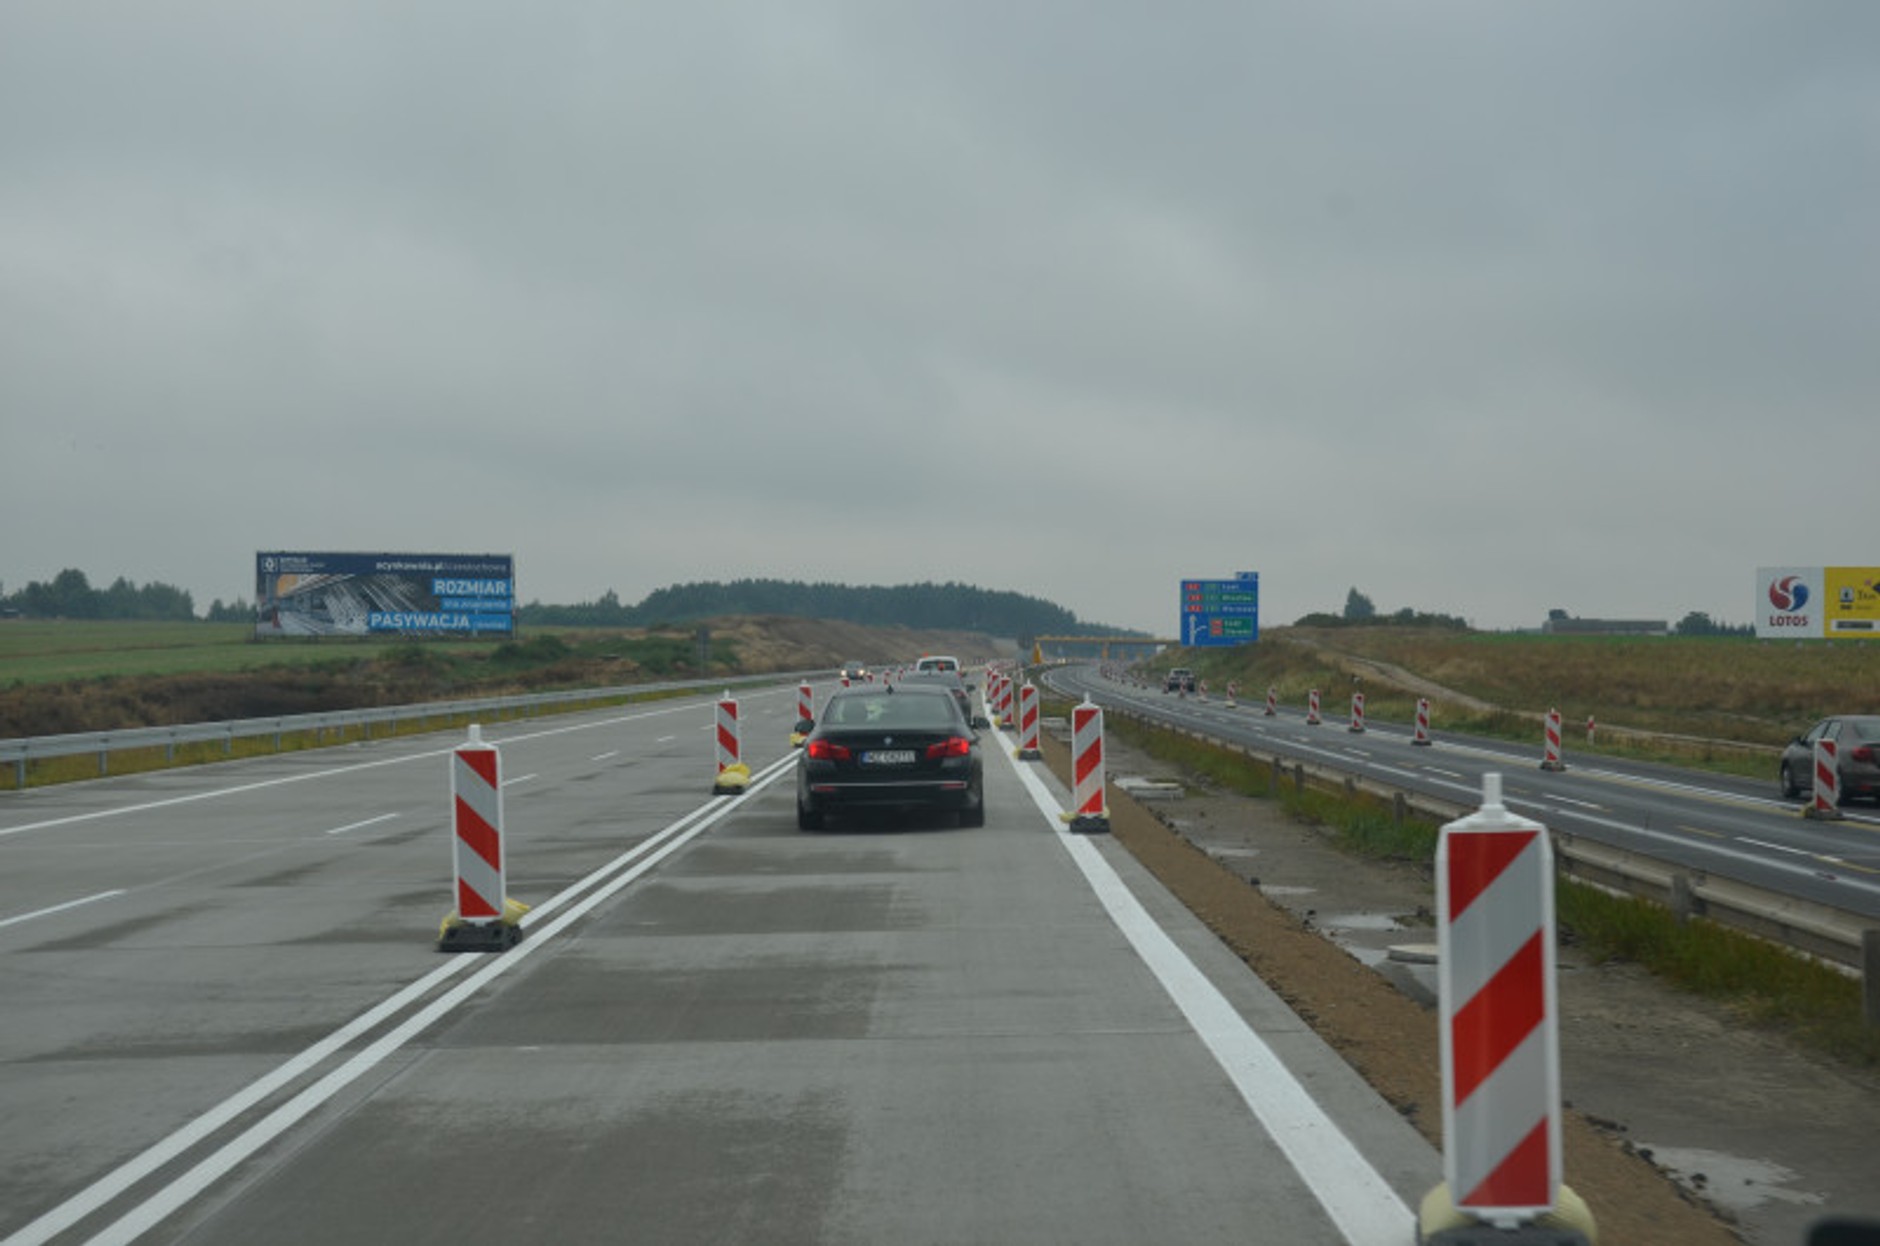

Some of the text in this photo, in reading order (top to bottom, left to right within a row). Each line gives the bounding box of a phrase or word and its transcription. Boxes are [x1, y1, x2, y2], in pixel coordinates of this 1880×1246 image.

[434, 580, 506, 595] ROZMIAR
[371, 613, 470, 627] PASYWACJA
[1769, 616, 1808, 627] LOTOS
